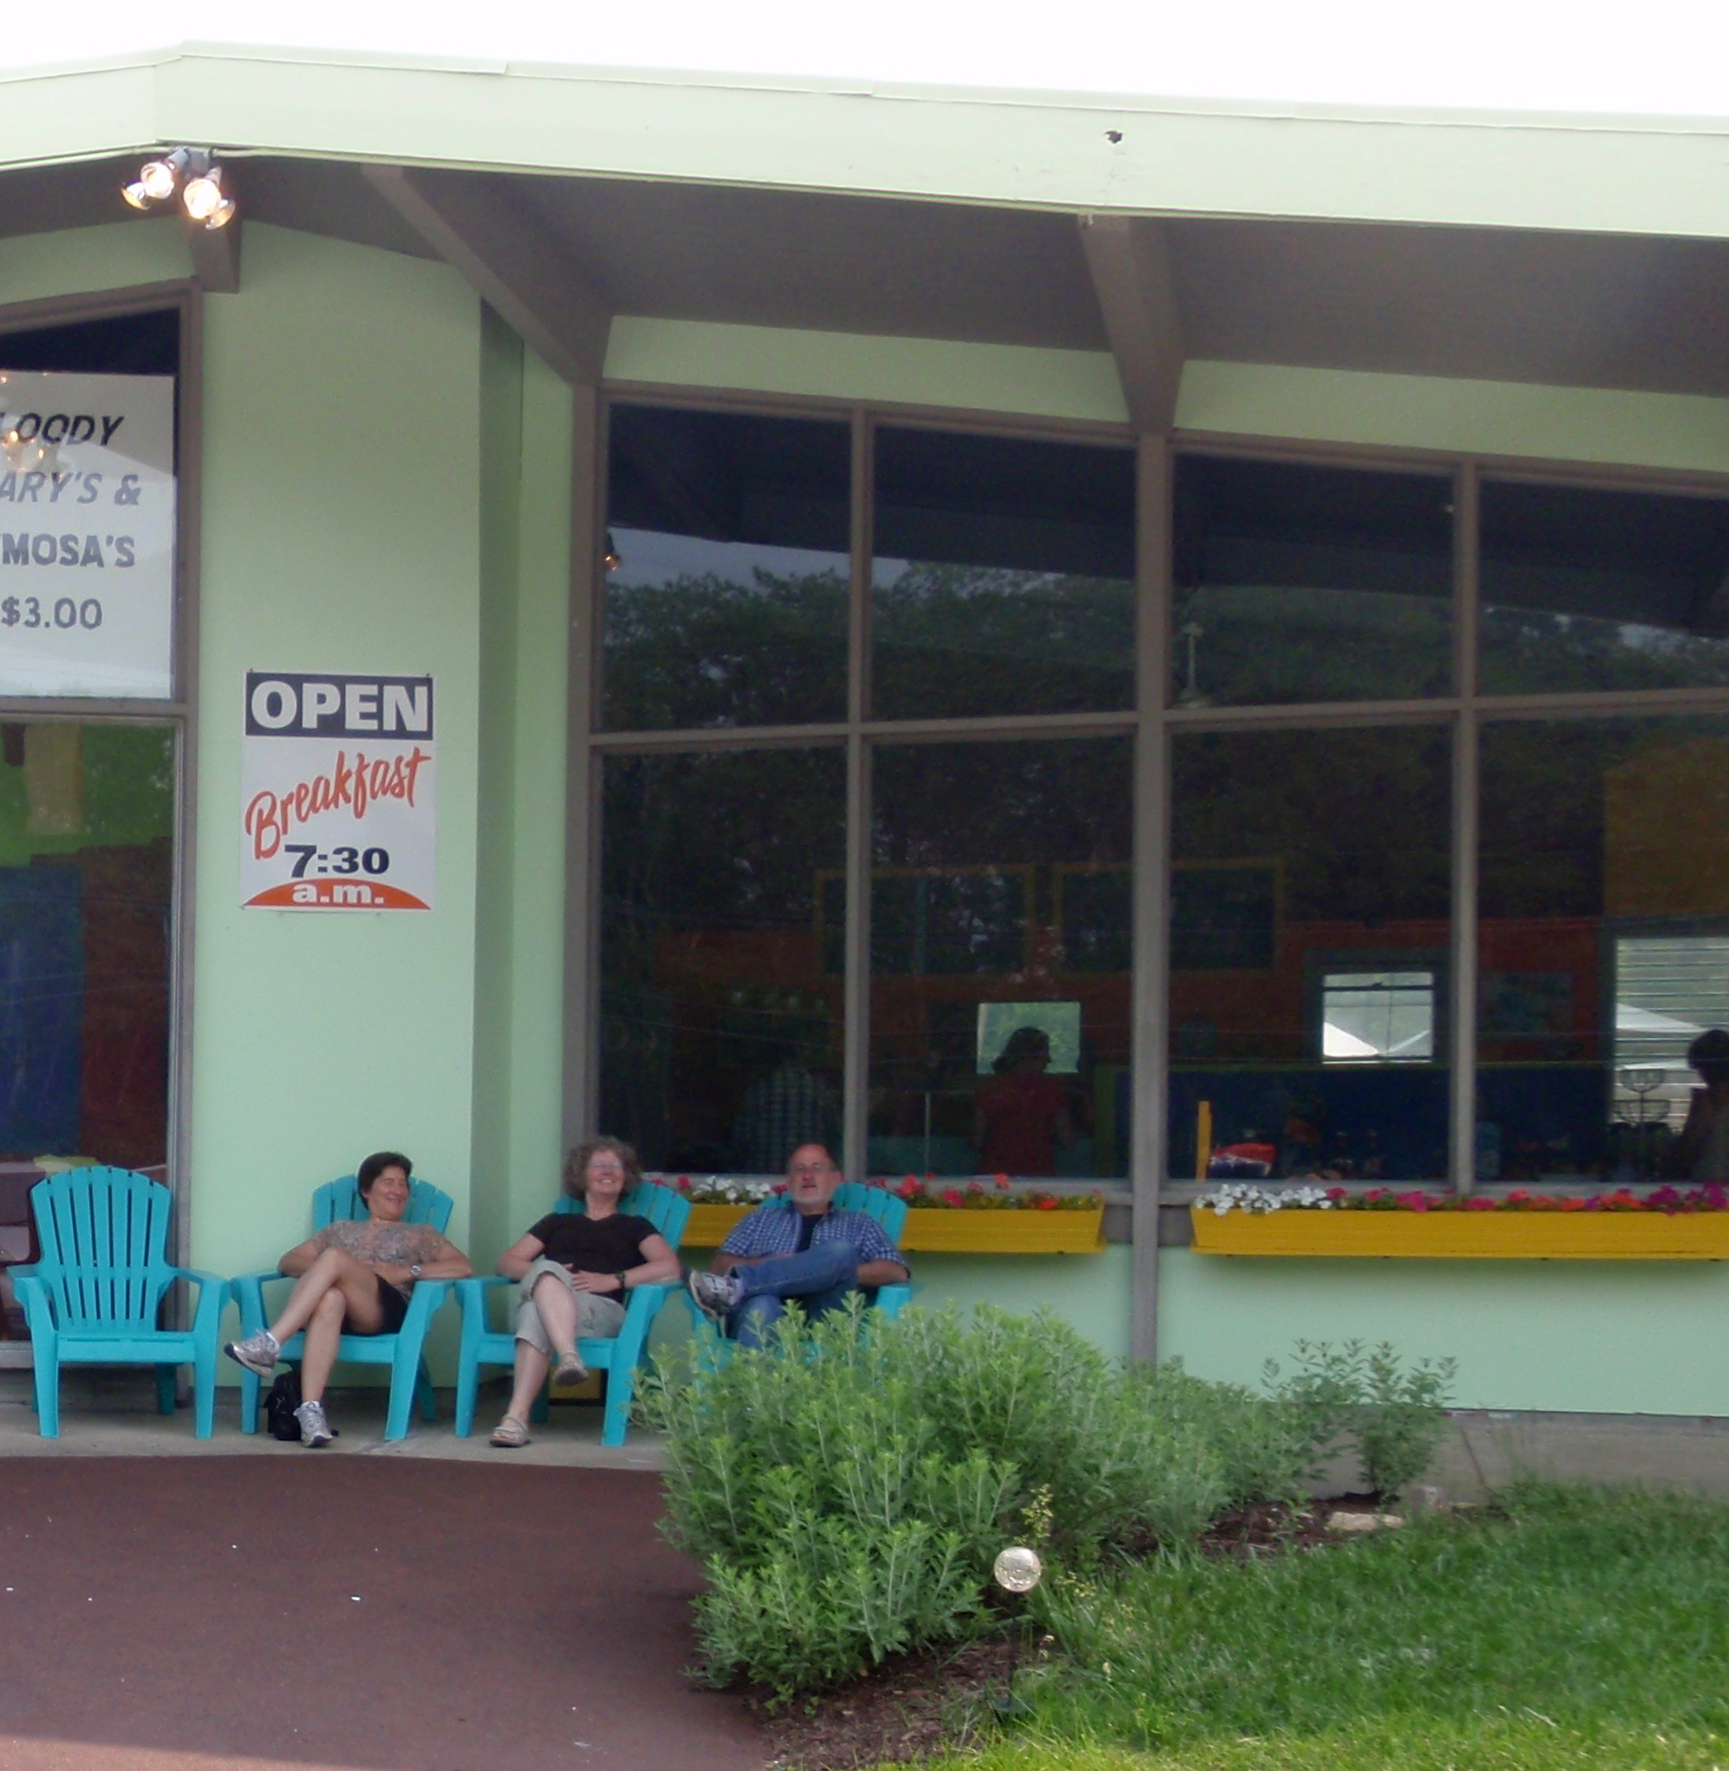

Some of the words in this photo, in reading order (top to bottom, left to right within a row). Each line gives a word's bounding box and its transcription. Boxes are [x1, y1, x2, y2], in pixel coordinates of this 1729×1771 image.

[114, 474, 142, 506] &
[0, 595, 103, 630] $3.00
[251, 680, 428, 732] OPEN
[244, 746, 432, 860] Breakfast
[283, 844, 390, 878] 7:30
[291, 883, 385, 905] a.m.
